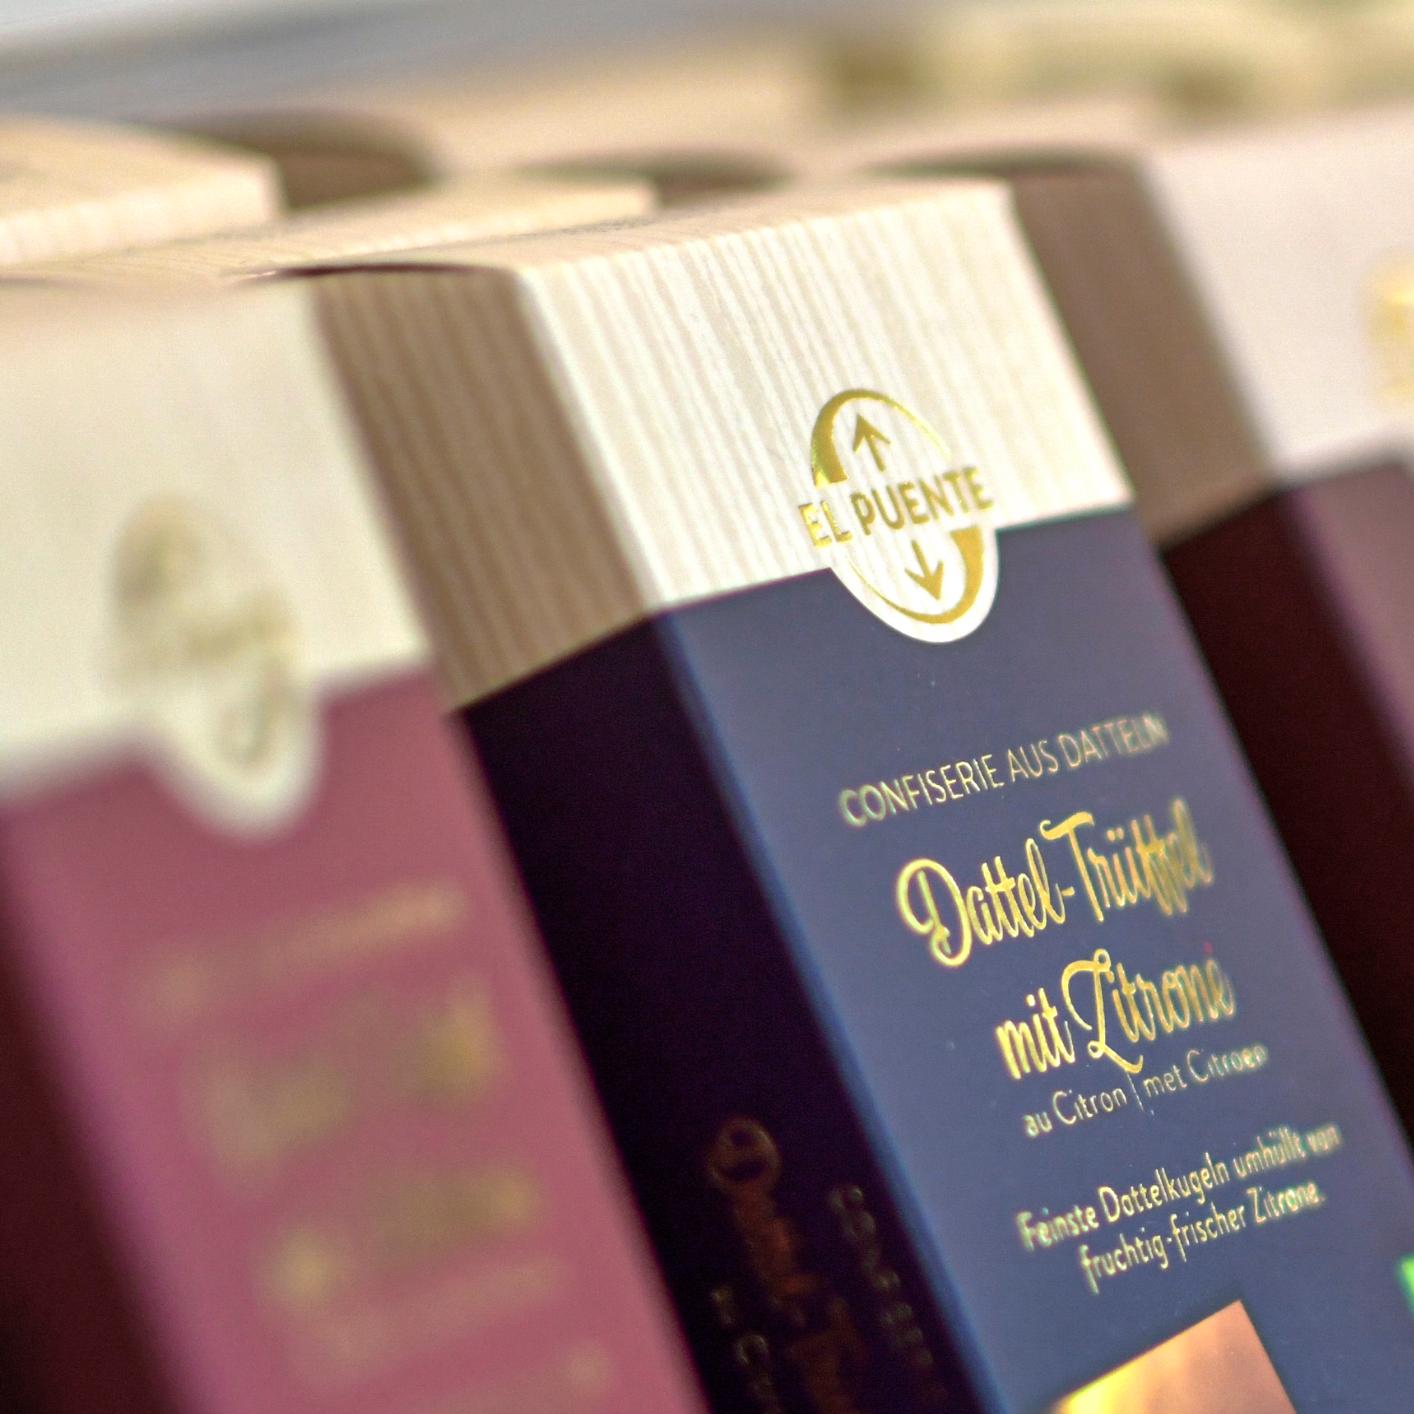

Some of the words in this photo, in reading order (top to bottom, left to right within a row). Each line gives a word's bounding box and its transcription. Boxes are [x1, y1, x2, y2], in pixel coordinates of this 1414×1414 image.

[798, 500, 852, 547] EL
[854, 467, 994, 535] PUENTE
[839, 753, 1005, 828] CONFISERIE
[1006, 739, 1059, 782] AUS
[1057, 712, 1169, 768] DATTELN
[896, 799, 1215, 967] Dattel-Trüffel
[995, 987, 1075, 1079] mit
[1062, 948, 1236, 1074] Zitrone
[1022, 1109, 1052, 1138] au
[1053, 1090, 1127, 1127] Citron
[1143, 1064, 1184, 1098] met
[1186, 1043, 1268, 1084] Citroen
[1016, 1205, 1099, 1251] Feinste
[1097, 1151, 1230, 1223] Dattelkugeln
[1232, 1126, 1306, 1179] umhüllt
[1305, 1122, 1342, 1154] von
